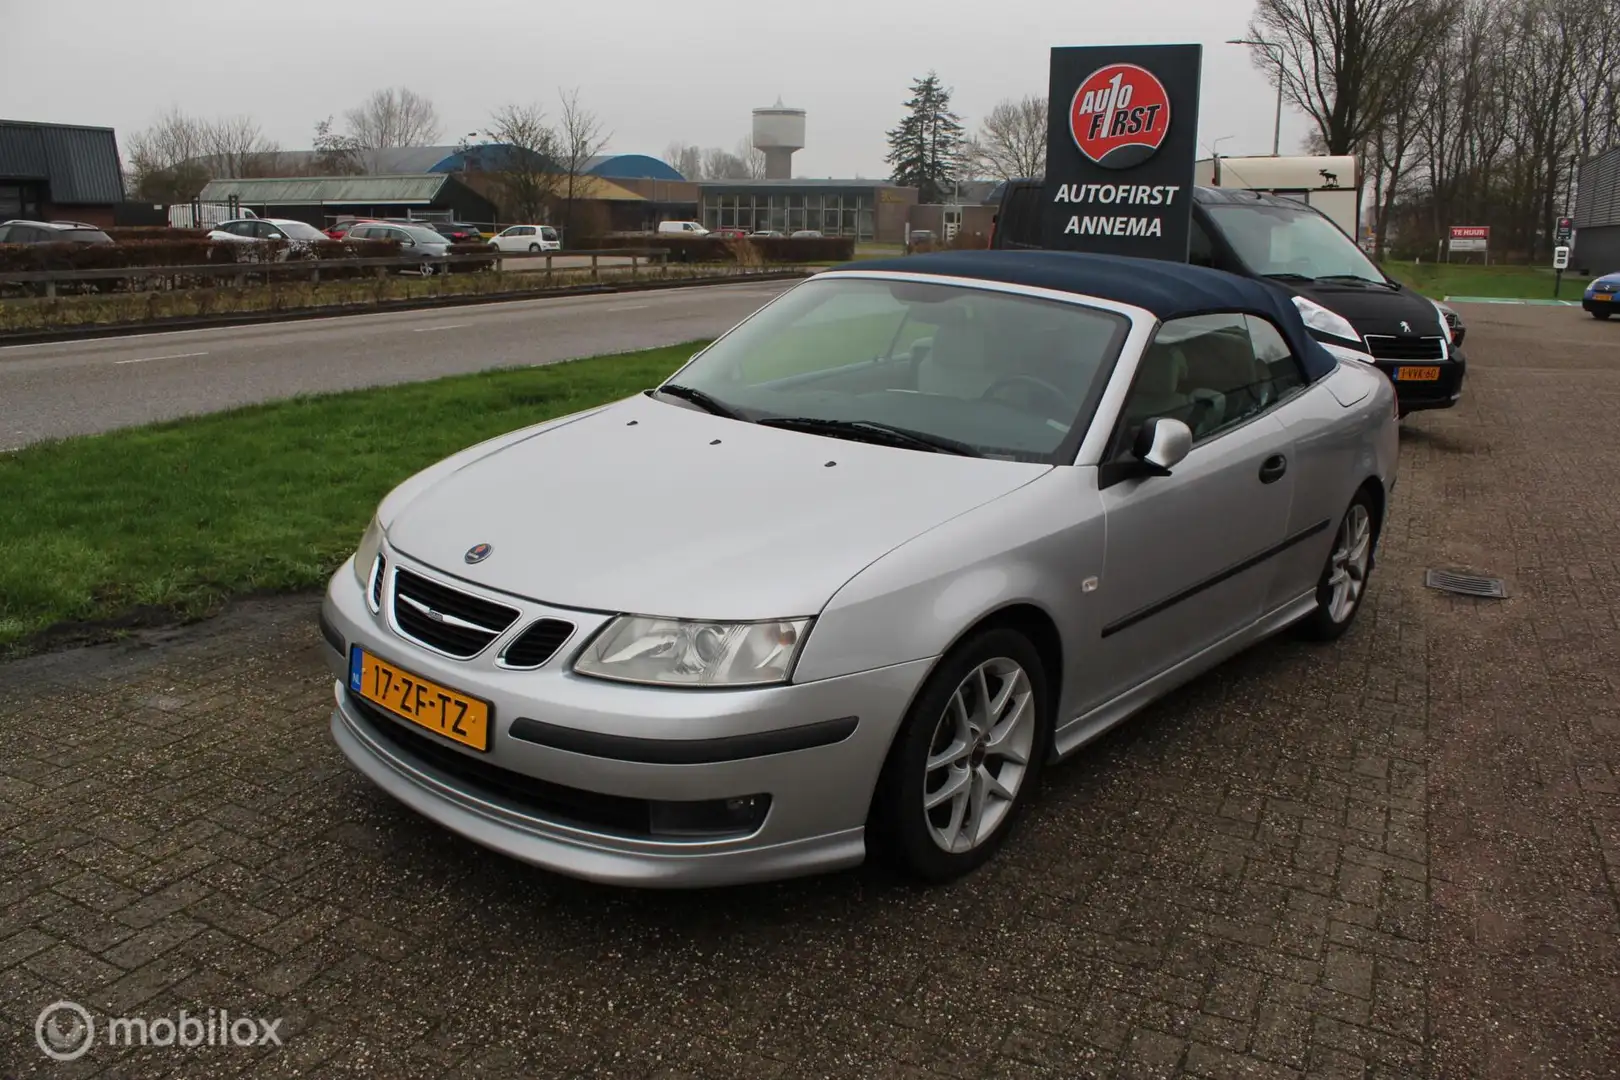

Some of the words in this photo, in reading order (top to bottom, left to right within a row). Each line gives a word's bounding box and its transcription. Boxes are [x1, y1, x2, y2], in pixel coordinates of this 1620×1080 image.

[1054, 183, 1180, 206] AUTOFIRST
[1064, 215, 1163, 237] ANNEMA
[374, 665, 469, 737] 17-ZF-TZ
